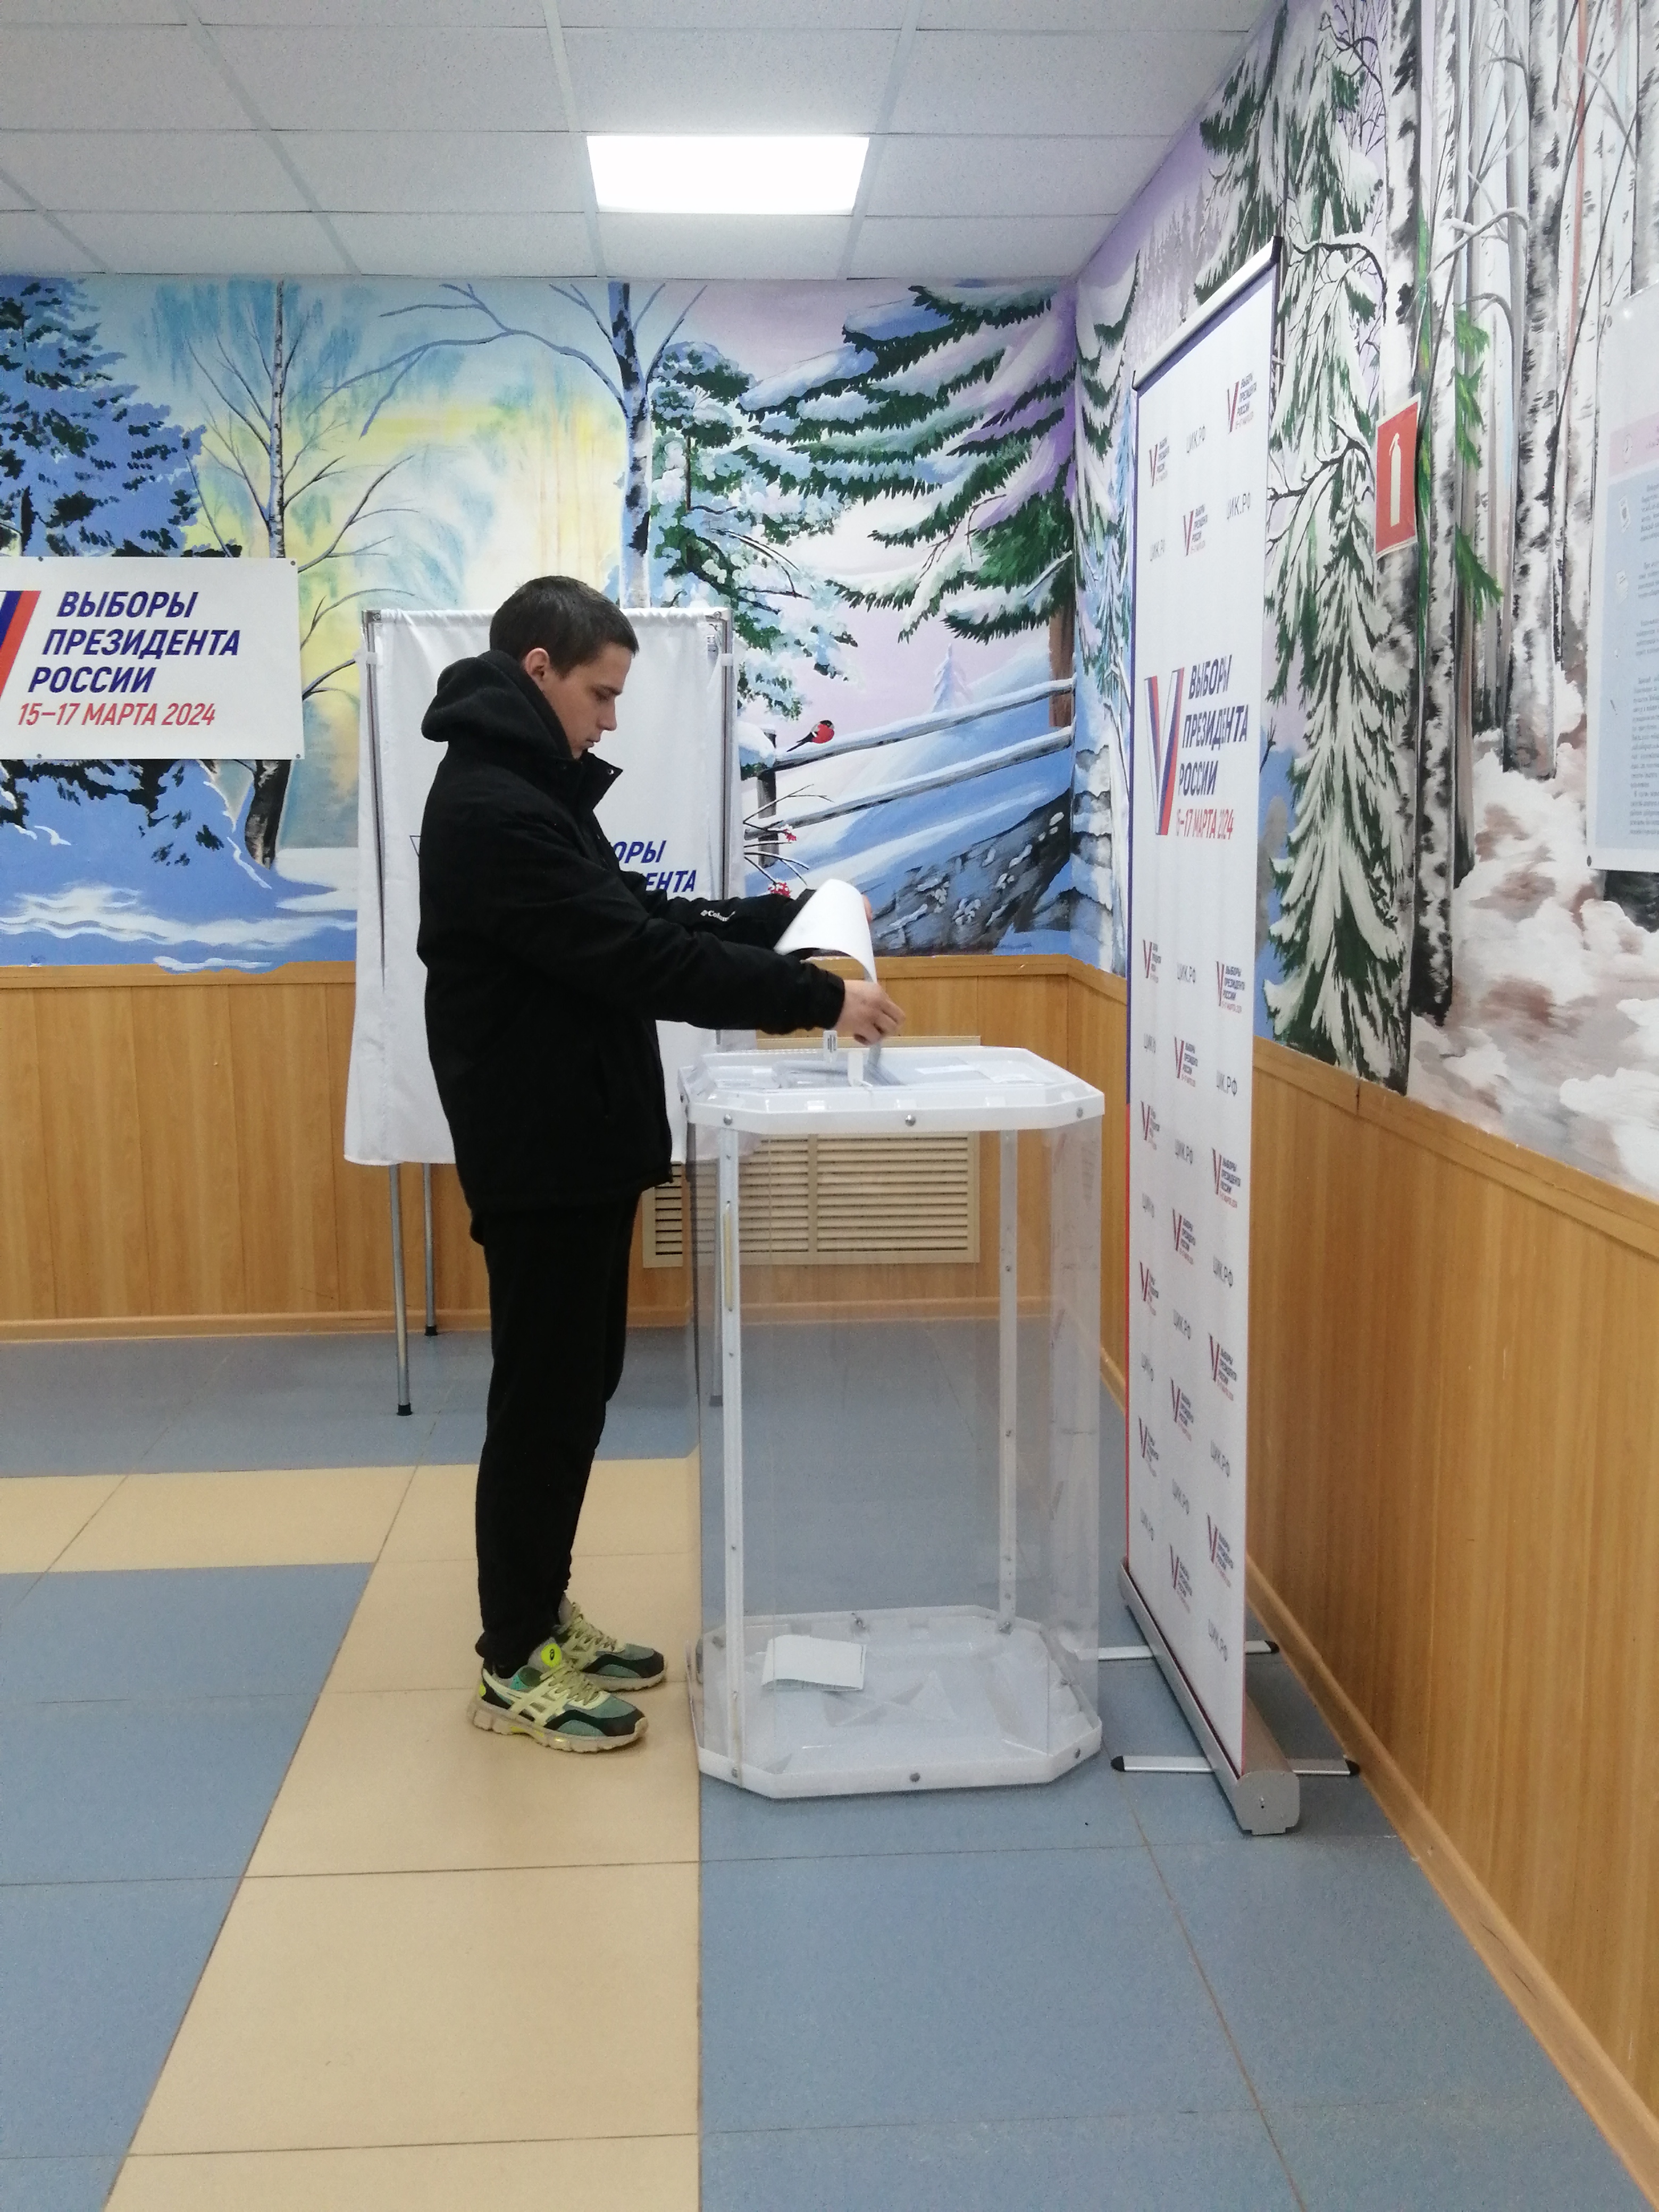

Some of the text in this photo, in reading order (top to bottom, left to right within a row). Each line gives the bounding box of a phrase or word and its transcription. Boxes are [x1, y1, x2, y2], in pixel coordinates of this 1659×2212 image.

[57, 591, 198, 617] ВЫБОРЫ
[43, 630, 240, 659] ПРЕЗИДЕНТА
[28, 667, 156, 693] РОССИИ
[1188, 654, 1232, 699] ВЫБОРЫ
[82, 703, 157, 726] МАРТА
[161, 703, 215, 726] 2024
[1182, 705, 1249, 751] ПРЕЗИДЕНТА
[1178, 760, 1218, 796] РОССИИ
[613, 840, 667, 864] ОРЫ
